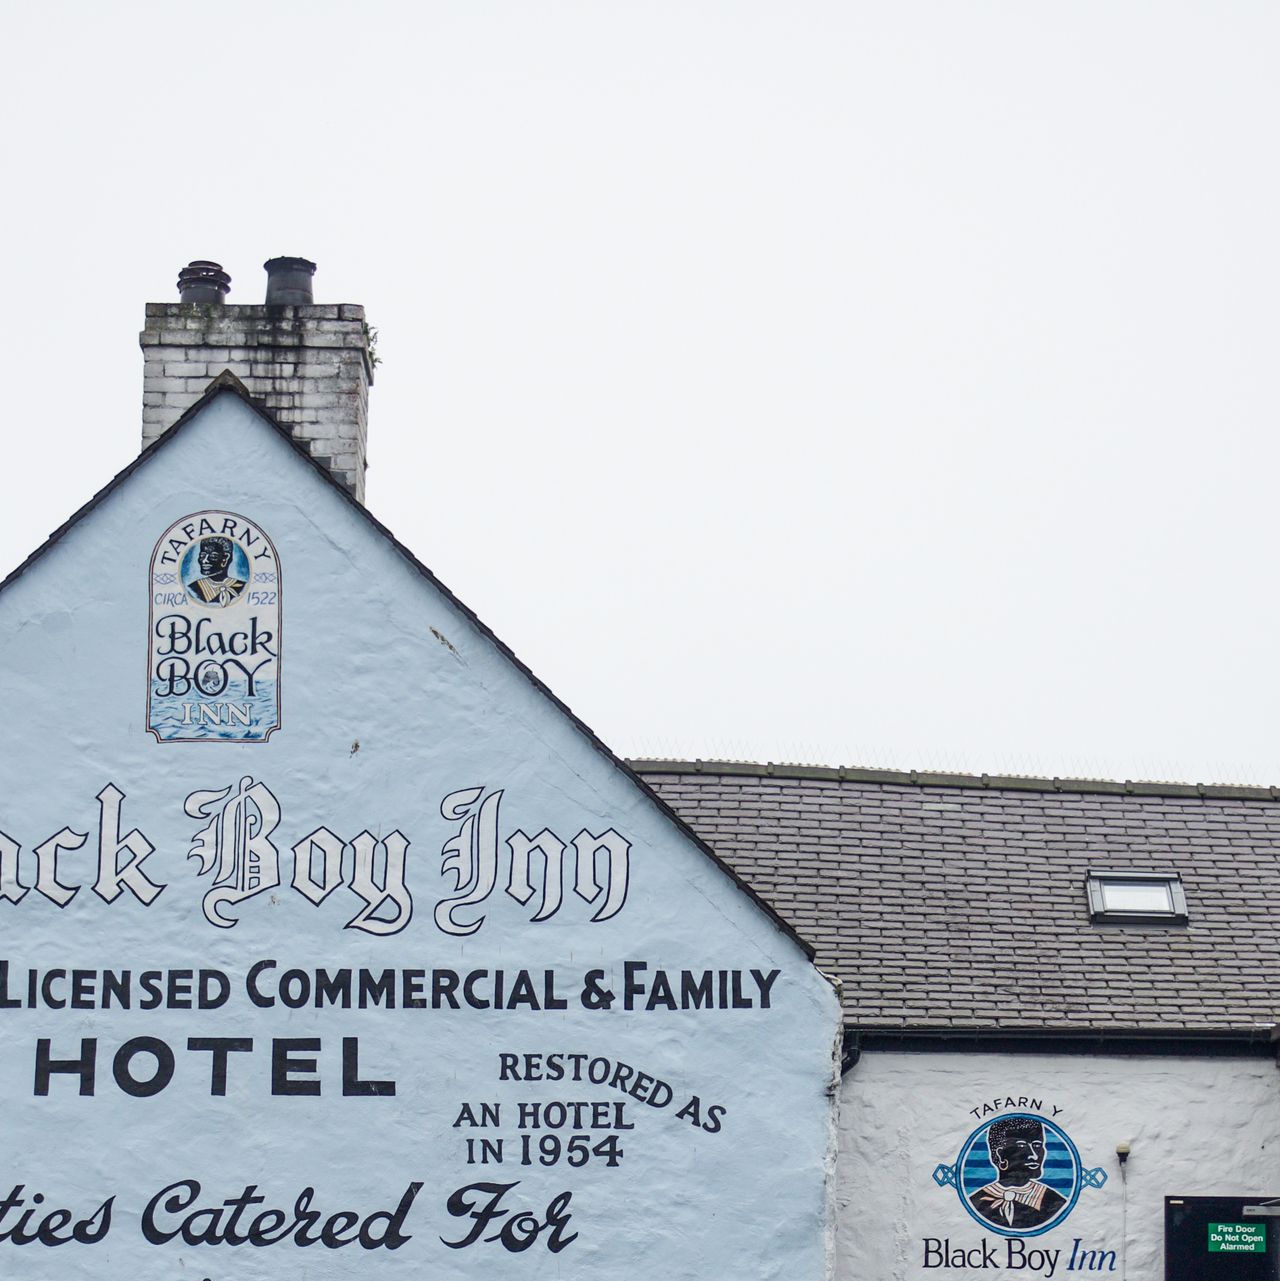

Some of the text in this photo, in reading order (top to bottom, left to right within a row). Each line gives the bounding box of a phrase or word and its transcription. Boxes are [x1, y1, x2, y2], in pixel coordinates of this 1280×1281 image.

[155, 592, 189, 606] CIRCA
[247, 591, 277, 605] 1522
[156, 614, 277, 657] Black
[155, 656, 272, 697] BOY
[181, 702, 253, 727] INN
[184, 774, 413, 937] Boy
[433, 785, 633, 938] Inn
[246, 960, 568, 1011] COMMERCIAL
[624, 961, 782, 1011] FAMILY
[33, 1036, 396, 1098] HOTEL
[499, 1053, 727, 1133] RESTORED AS
[969, 1096, 1063, 1120] TAFARN Y
[452, 1101, 635, 1130] AN HOTEL
[466, 1134, 624, 1168] IN 1954
[141, 1178, 425, 1252] Catered
[439, 1179, 580, 1254] For
[1218, 1225, 1256, 1233] Fire Door
[1211, 1233, 1223, 1241] Do
[1241, 1234, 1264, 1243] Open
[1220, 1242, 1255, 1251] Alarmed
[922, 1238, 1117, 1279] Black Boy Inn
